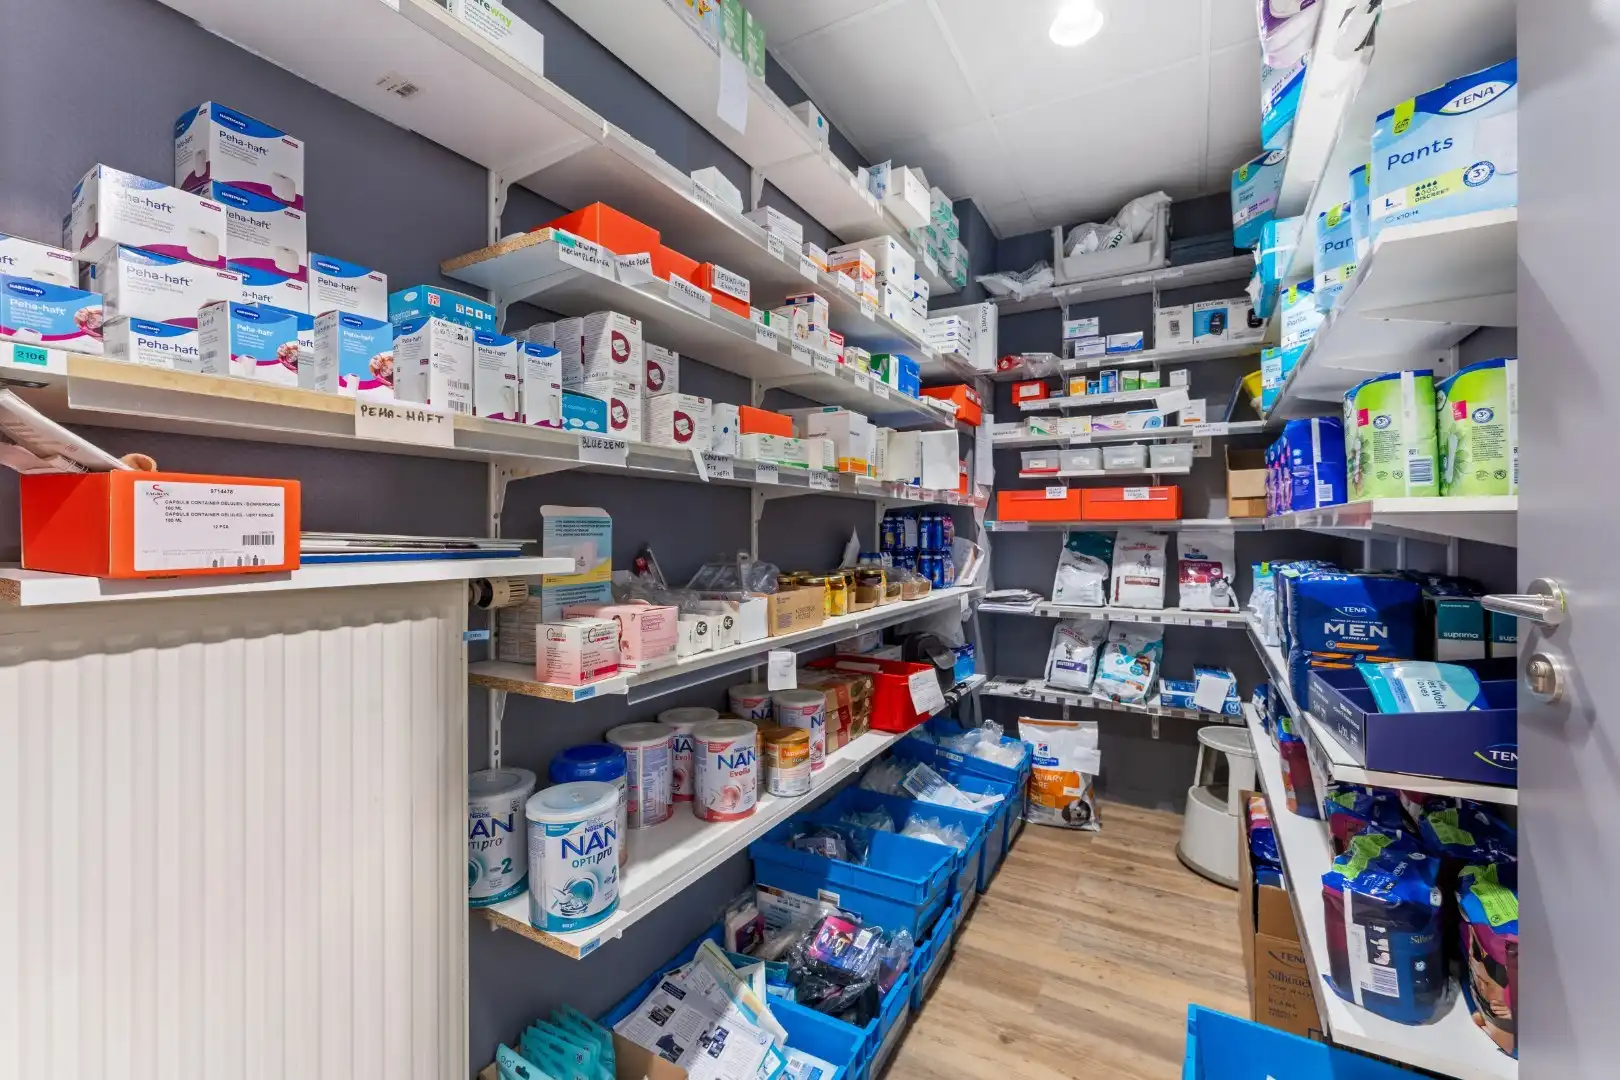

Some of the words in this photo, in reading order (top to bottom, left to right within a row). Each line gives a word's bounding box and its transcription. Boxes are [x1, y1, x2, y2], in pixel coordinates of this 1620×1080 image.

[1454, 86, 1494, 108] TENA
[219, 130, 268, 156] Peha-haft
[1387, 137, 1453, 171] Pants
[1386, 198, 1394, 207] L
[226, 210, 271, 230] eha-haft
[1324, 237, 1354, 255] Pan
[126, 265, 190, 287] Peha-haft
[317, 276, 358, 293] Peha-haft
[9, 283, 43, 295] HARTMANN
[10, 298, 66, 316] Peha-haft
[237, 323, 273, 337] Peha-haft
[138, 337, 200, 357] Peha-haft
[17, 351, 45, 362] 2106
[1324, 622, 1388, 639] MEN
[1443, 631, 1478, 640] suprima
[675, 753, 693, 761] Evoli
[1489, 750, 1518, 761] TEN
[561, 820, 617, 860] NAN
[500, 857, 513, 875] 2
[611, 864, 618, 885] 2
